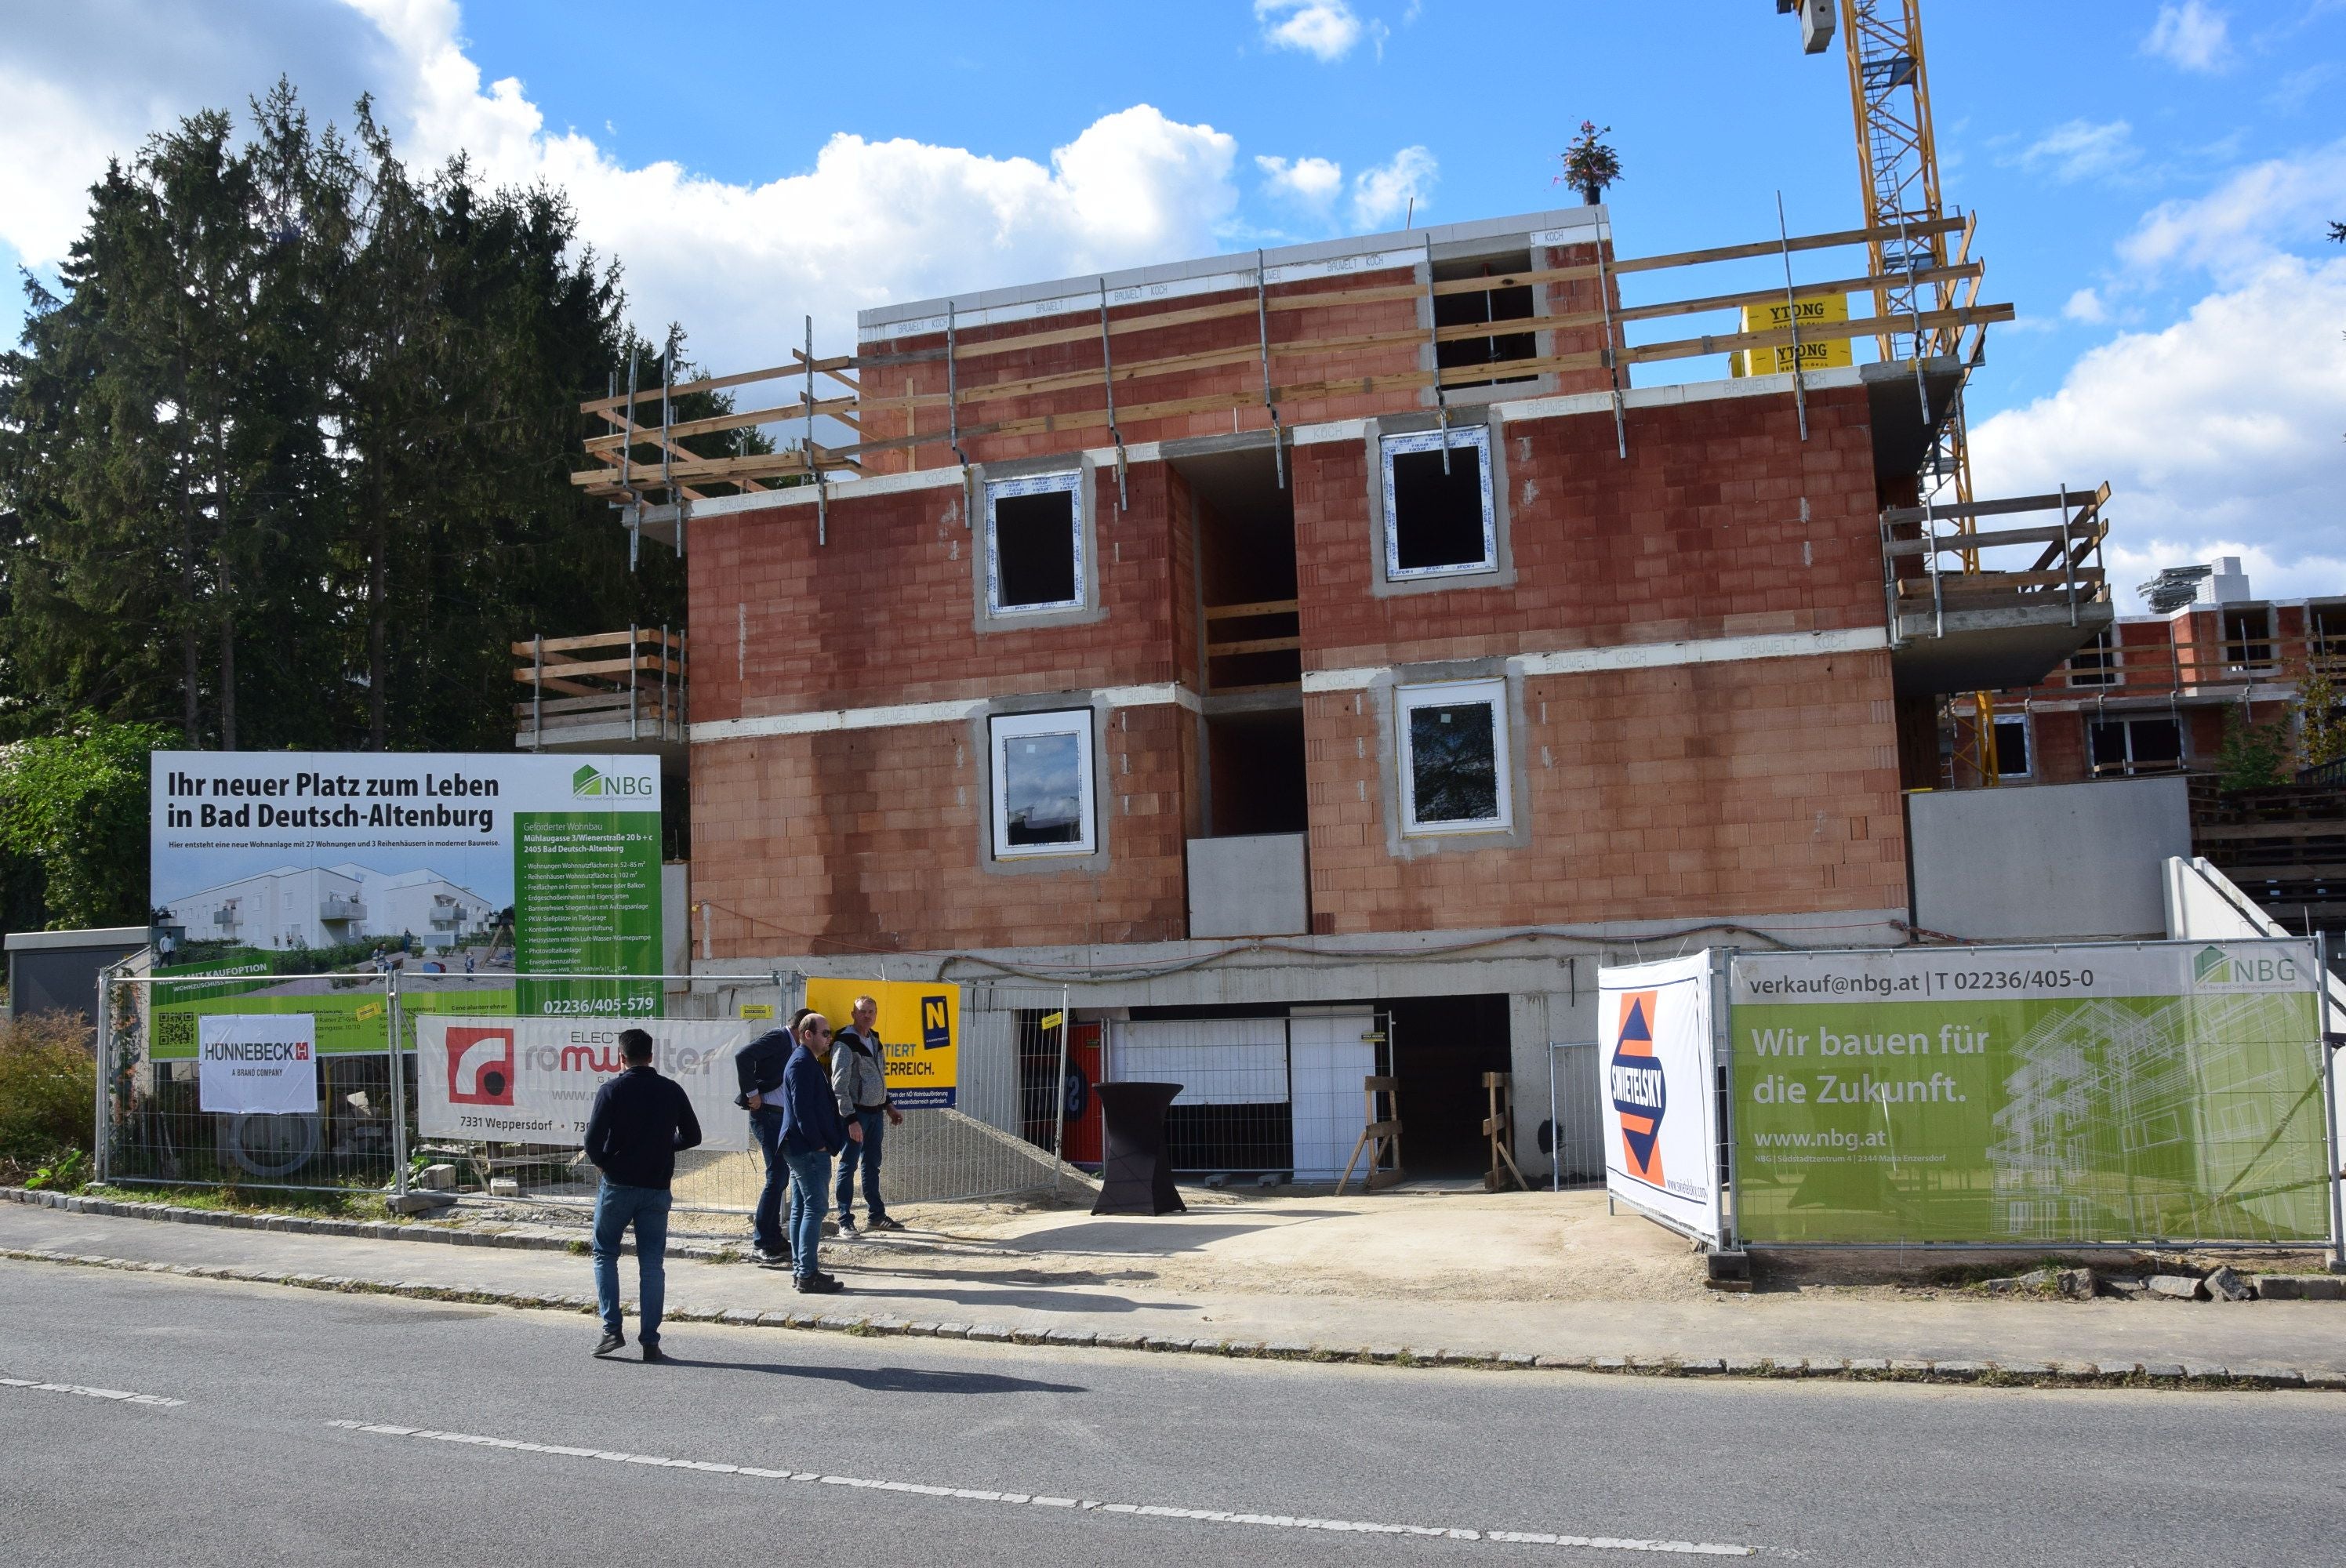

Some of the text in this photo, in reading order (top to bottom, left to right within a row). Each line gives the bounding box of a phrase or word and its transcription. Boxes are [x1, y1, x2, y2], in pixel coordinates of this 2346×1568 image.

[1545, 230, 1563, 242] KOCH
[1327, 255, 1384, 272] BAUWELT KOCH
[1114, 285, 1168, 302] BAUWELT KOCH
[1035, 300, 1064, 314] BAUWELT
[1770, 303, 1825, 320] YTONG
[898, 318, 948, 334] BAUWELT KOCH
[1777, 343, 1828, 361] YTONG
[1724, 372, 1828, 394] BAUWELT OCH
[1527, 397, 1580, 415] BAUWELT
[1313, 424, 1342, 440] KOCH
[868, 470, 951, 492] BAUWELT KOCH
[719, 491, 797, 511] BAUWELT KOCH
[1741, 636, 1847, 655] BAUWELT KOCH
[1545, 650, 1647, 670] BAUWELT KOCH
[873, 706, 957, 722] BAUWELT KOCH
[719, 718, 798, 735] BAUWELT KOCH
[169, 772, 499, 797] Ihr neuer Platz zum Leben
[605, 776, 652, 795] NBG
[168, 803, 493, 833] in Bad Deutsch-Altenburg
[524, 822, 603, 831] Geförderter Wohnbau
[316, 840, 356, 849] Wohnungen
[524, 834, 570, 844] Mühlaugasse
[572, 833, 625, 842] 3/Wienerstraße
[558, 845, 624, 854] Deutsch-Altenburg
[528, 894, 586, 902] Erdgeschoßeinheiten
[597, 893, 630, 902] Eigengärten
[529, 936, 560, 945] Heizsystem
[205, 963, 267, 978] KAUFOPTION
[2234, 958, 2296, 983] NBG
[1750, 970, 2094, 996] verkauf@nbg.at T 02236/405-0
[543, 996, 655, 1014] 02236/405-579
[926, 1002, 946, 1030] N
[1751, 1024, 1989, 1057] Wir bauen für
[205, 1042, 295, 1061] HÜNNEBECK
[525, 1038, 712, 1075] romwlter
[1611, 1064, 1662, 1109] SWIETELSKY
[1753, 1073, 1966, 1104] die Zukunft.
[460, 1116, 483, 1127] 7331
[485, 1117, 553, 1132] Weppersdorf
[1754, 1130, 1887, 1151] www.nbg.at
[1778, 1154, 1846, 1163] Südstadtzentrum
